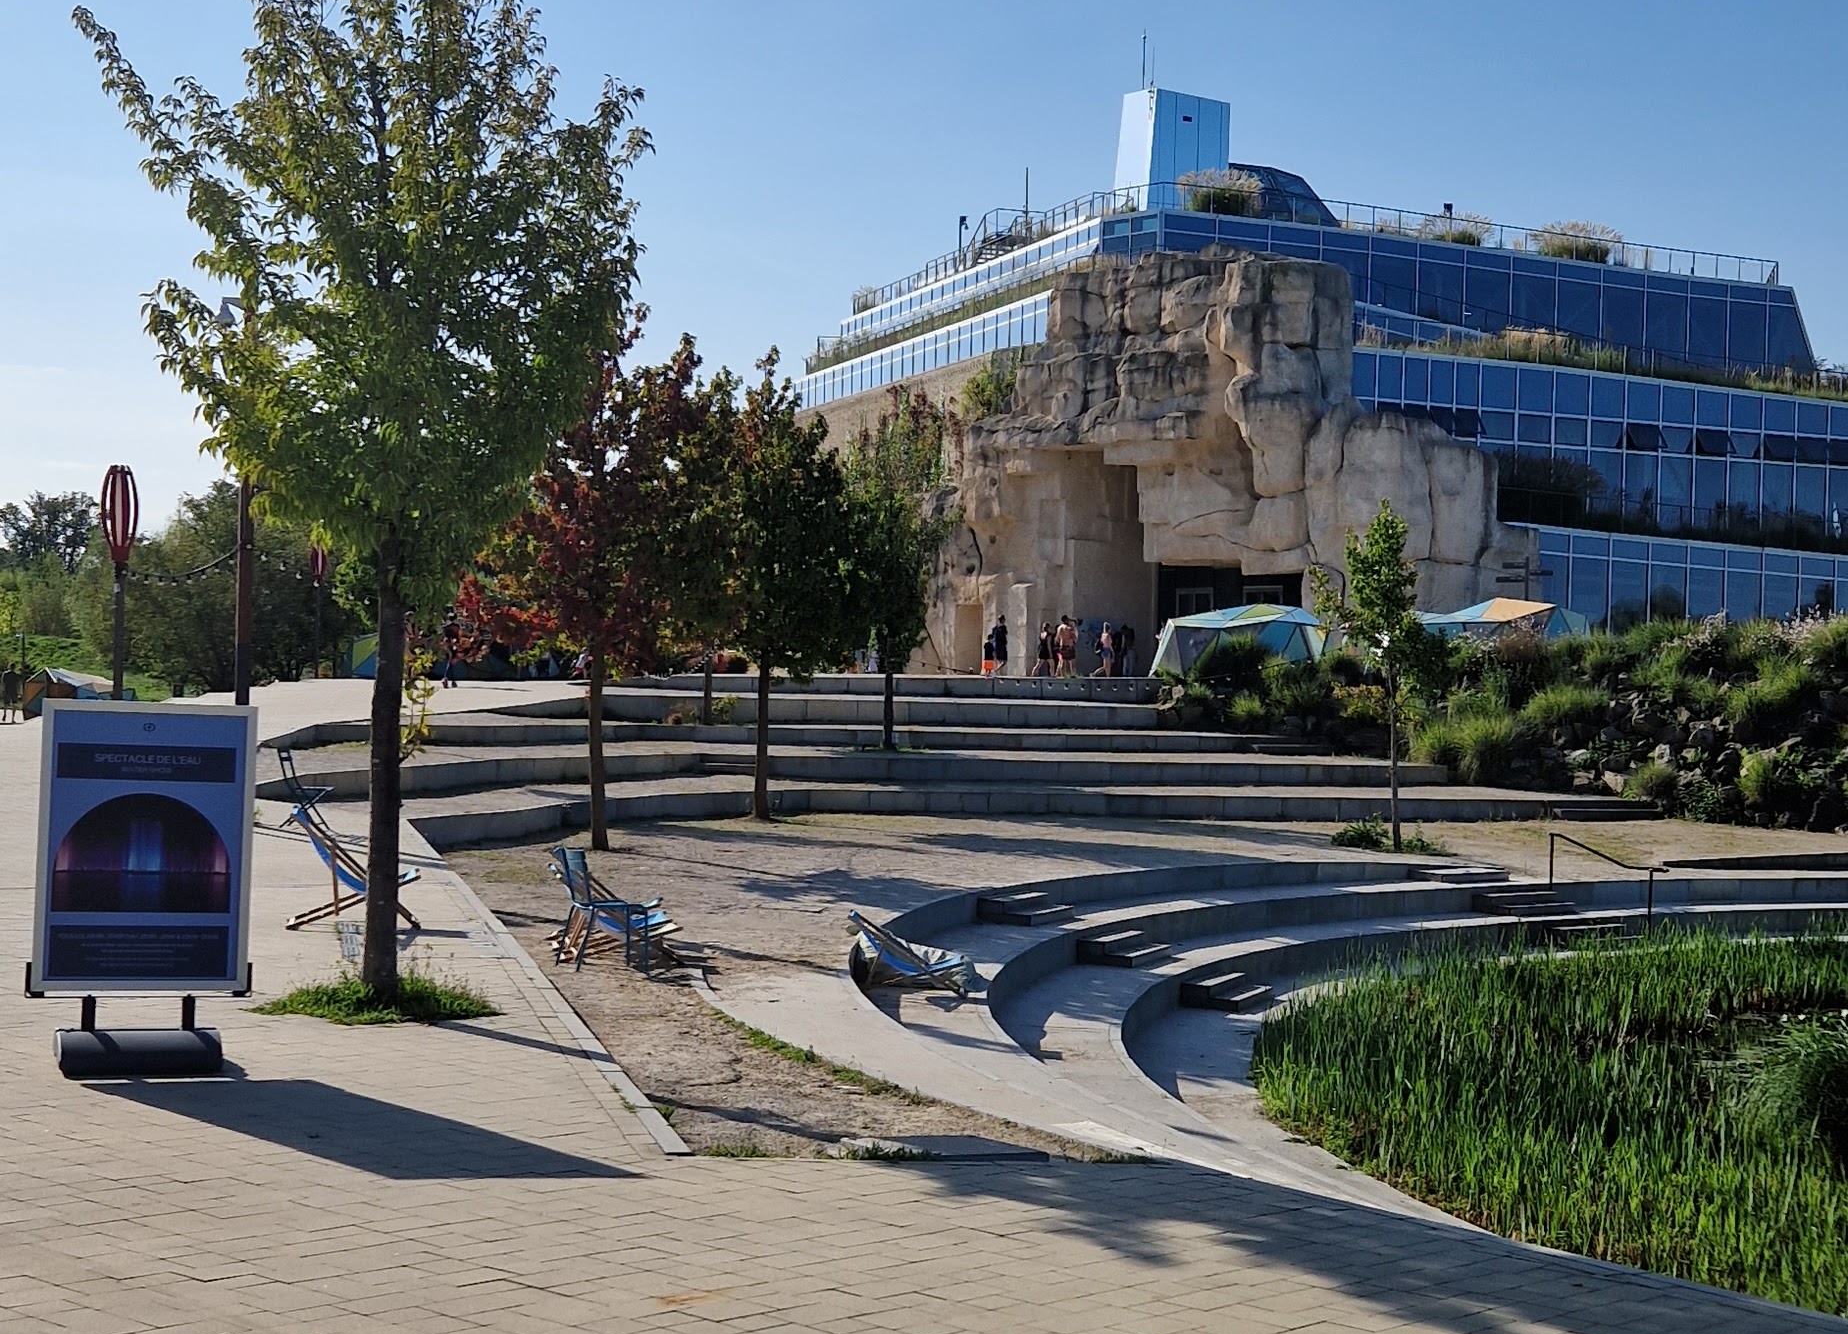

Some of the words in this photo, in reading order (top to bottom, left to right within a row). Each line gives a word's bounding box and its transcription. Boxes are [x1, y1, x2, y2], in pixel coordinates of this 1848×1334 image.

[94, 753, 155, 764] SPECTACLE
[156, 754, 171, 764] DE
[172, 755, 202, 765] L'EAU
